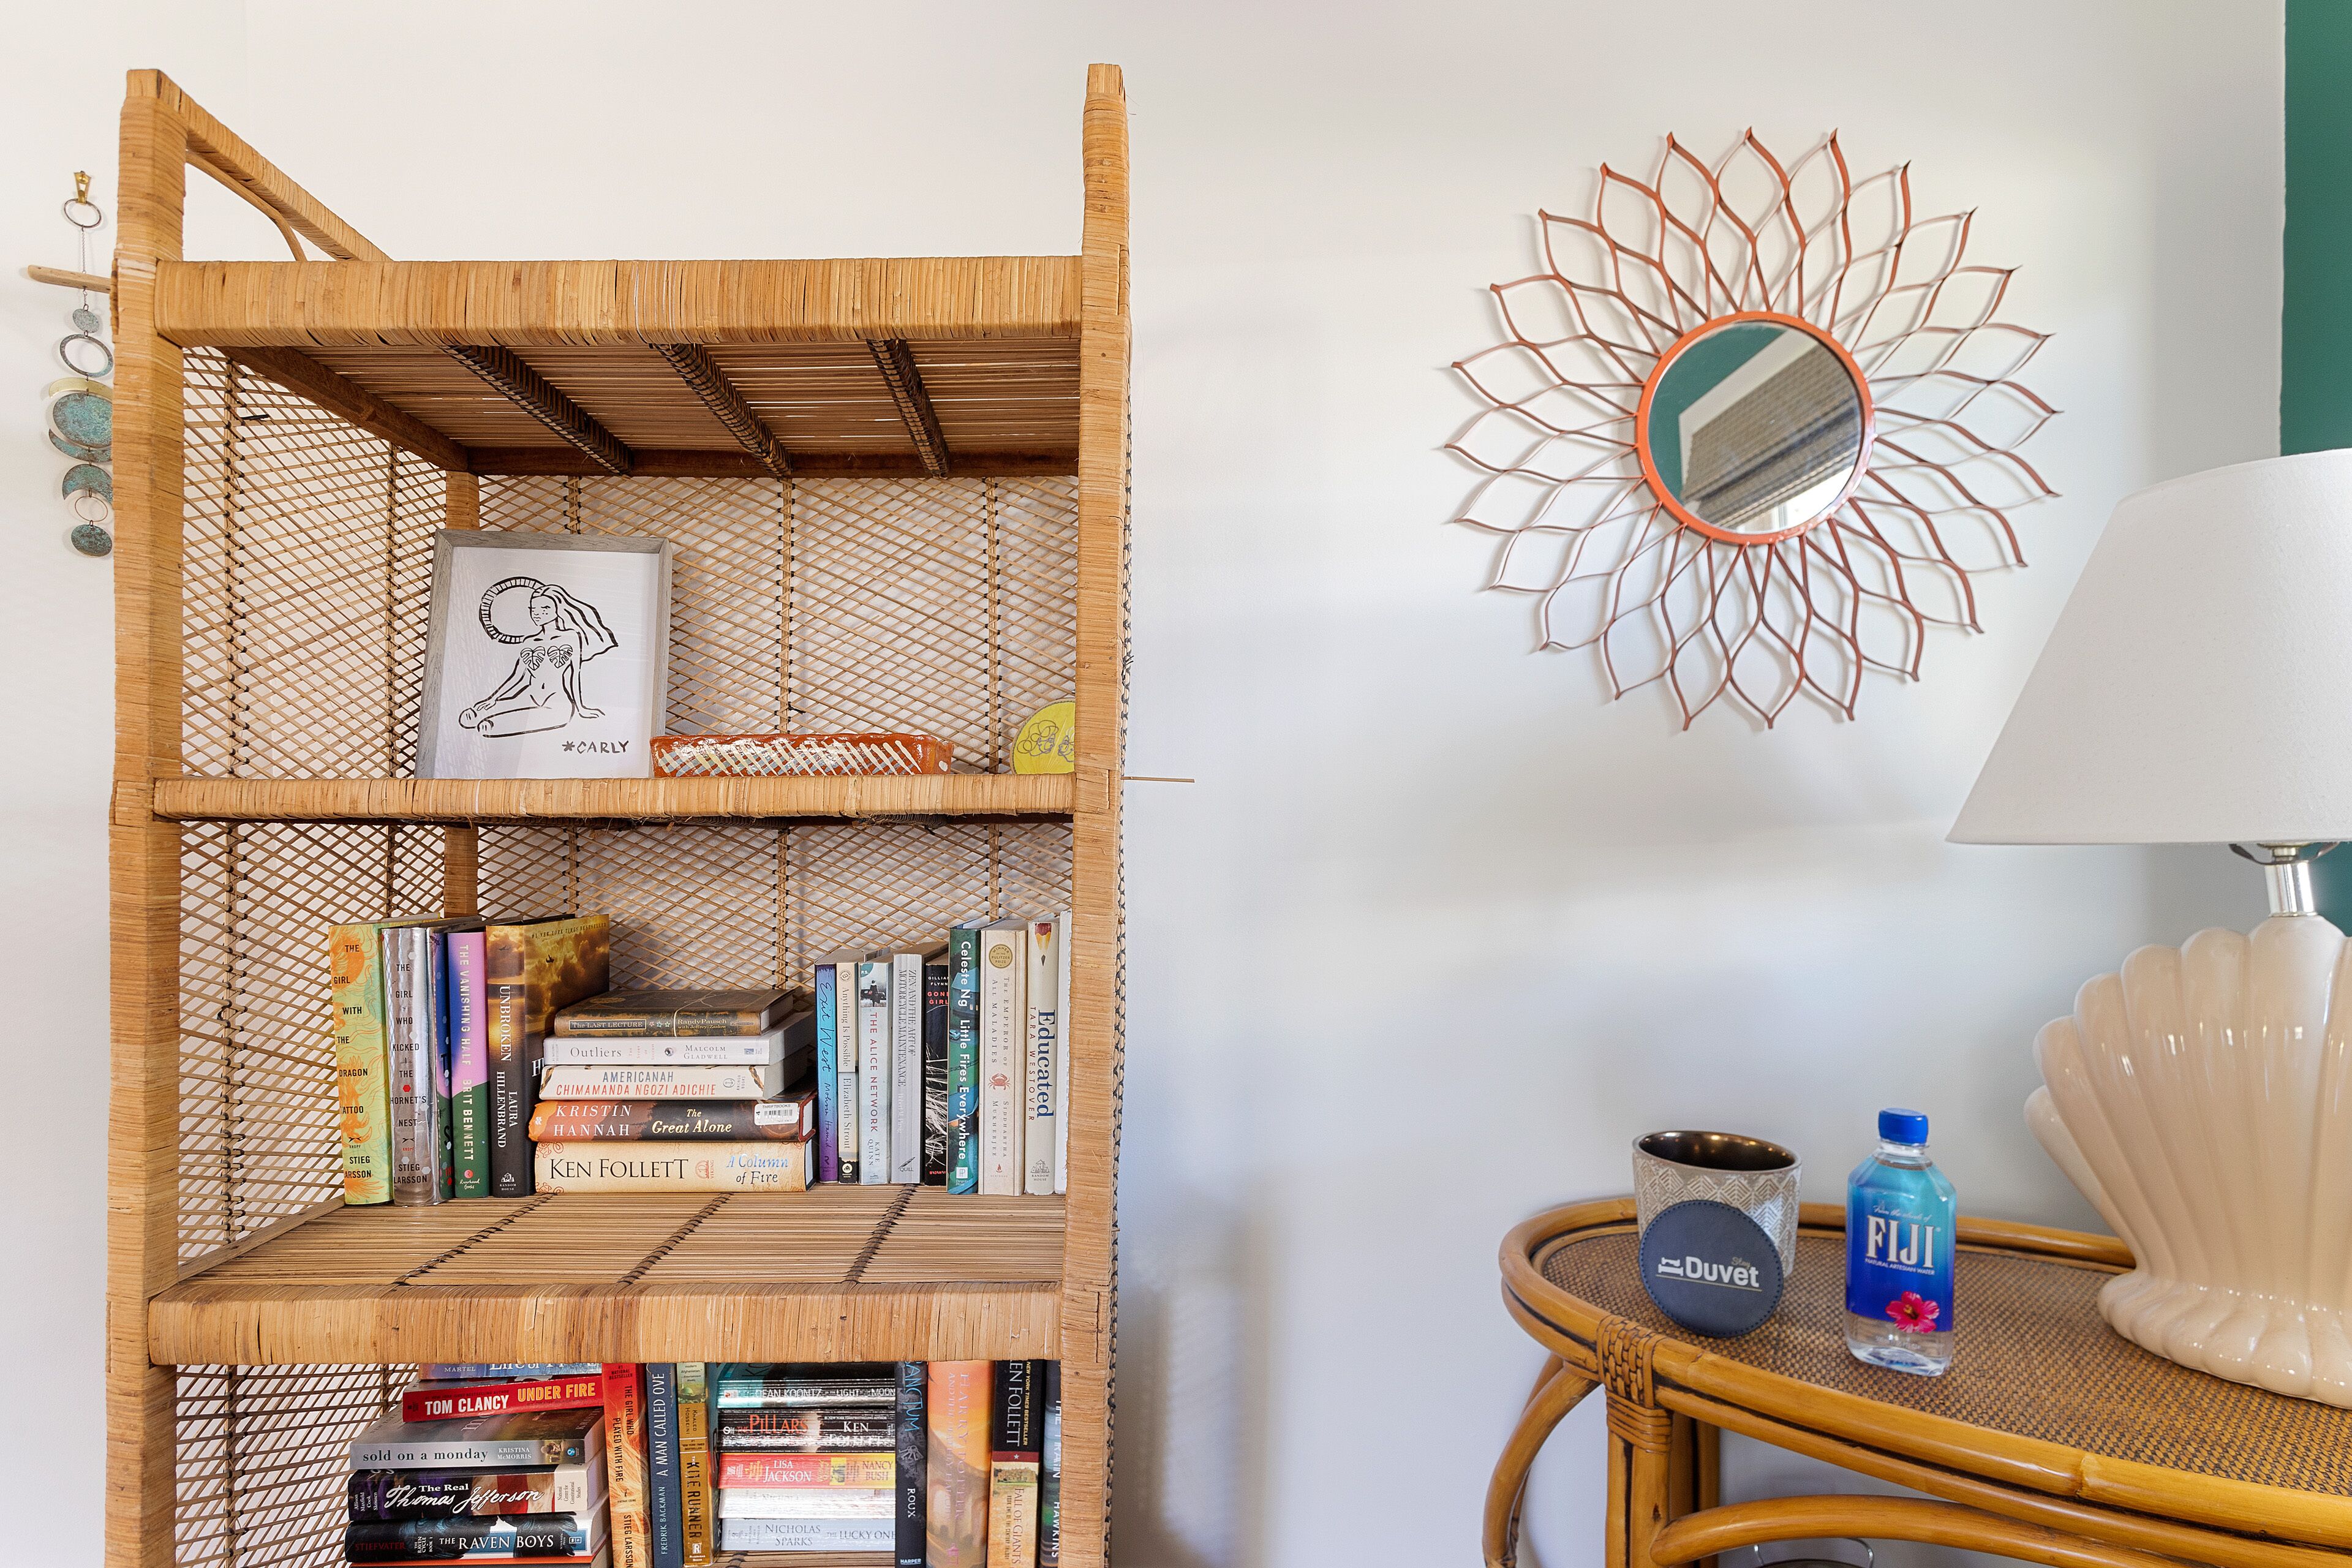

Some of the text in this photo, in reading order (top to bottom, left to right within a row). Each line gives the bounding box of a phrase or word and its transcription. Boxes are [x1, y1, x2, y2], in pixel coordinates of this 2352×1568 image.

[840, 987, 850, 1024] Anything
[499, 985, 511, 1061] UNBROKEN
[820, 982, 835, 1072] Exit West
[898, 970, 907, 1087] MOTORCYCLE MAINTENANCE
[459, 944, 474, 1161] THE VANISHING HALF BRIT BENNETT
[570, 1047, 622, 1058] Outliers
[908, 1045, 916, 1056] OF
[957, 941, 972, 1159] Celeste Ng Little Fires Everywhere
[1003, 1057, 1008, 1066] OF
[1036, 1009, 1055, 1118] Educated
[339, 1068, 368, 1077] DRAGON
[602, 1071, 674, 1082] AMERICANAH
[556, 1084, 716, 1096] CHIMAMANDA NGOZI ADICHIE
[843, 1078, 852, 1118] Elizabeth
[390, 1096, 426, 1105] HORNET'S
[497, 1071, 507, 1148] HILLENBRAND
[509, 1091, 518, 1127] LAURA
[556, 1105, 632, 1117] KRISTIN
[687, 1109, 701, 1117] The
[398, 1118, 417, 1127] NEST
[554, 1124, 630, 1136] HANNAH
[652, 1120, 733, 1134] Great Alone
[843, 1122, 852, 1148] Strout
[349, 1156, 370, 1164] STIEG
[398, 1163, 420, 1172] STIEG
[726, 1154, 789, 1168] A Column
[549, 1159, 688, 1179] KEN FOLLETT
[393, 1175, 428, 1184] LARSSON
[736, 1171, 778, 1185] of Fire
[1866, 1215, 1934, 1268] FIJI
[1731, 1257, 1751, 1269] Stay
[1865, 1257, 1888, 1268] NATURAL
[1686, 1256, 1760, 1287] Duvet
[652, 1373, 665, 1395] OVE
[424, 1398, 453, 1415] TOM
[458, 1395, 509, 1413] CLANCY
[518, 1385, 561, 1403] UNDER
[566, 1382, 596, 1398] FIRE
[653, 1400, 667, 1436] CALLED
[748, 1414, 809, 1434] PILLARS
[1006, 1387, 1023, 1447] FOLLETT
[363, 1450, 391, 1461] sold
[434, 1448, 488, 1462] monday
[655, 1441, 668, 1465] MAN
[774, 1460, 793, 1469] LISA
[862, 1461, 894, 1470] NANCY
[763, 1466, 812, 1482] JACKSON
[865, 1472, 889, 1480] BUSH
[384, 1485, 545, 1514] Thomas Jefferson
[687, 1462, 702, 1538] KITE RUNNER
[907, 1488, 916, 1518] ROUX
[766, 1524, 821, 1534] NICHOLAS
[1012, 1488, 1024, 1564] FALL OF GIANTS
[1051, 1502, 1060, 1558] HAWKINS
[459, 1536, 510, 1550] RAVEN
[516, 1534, 554, 1548] BOYS
[660, 1525, 668, 1554] FREDRIK
[775, 1537, 813, 1546] SPARKS
[840, 1531, 895, 1539] LUCKY ONE
[625, 1537, 633, 1568] LARSSON
